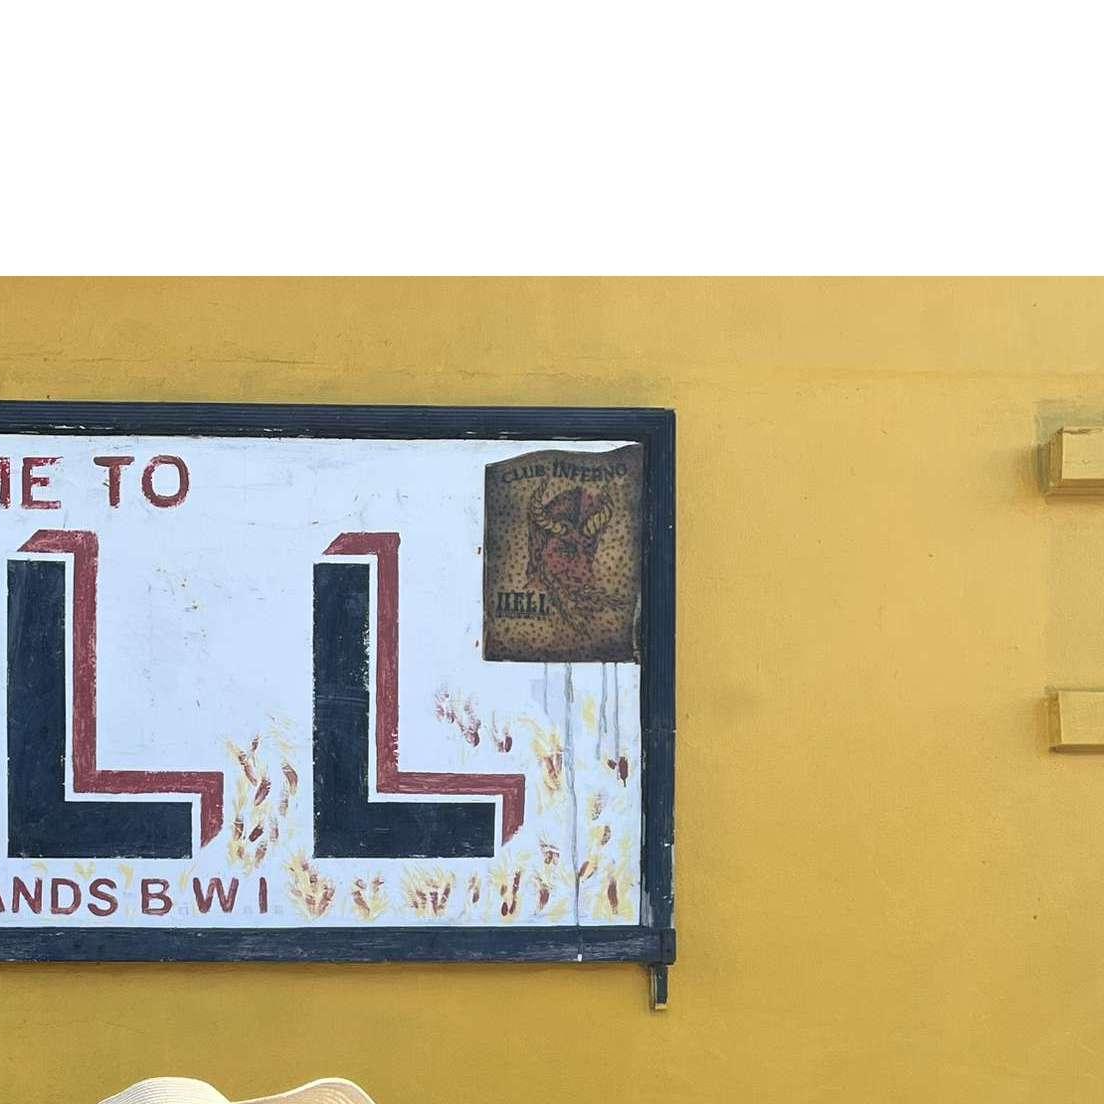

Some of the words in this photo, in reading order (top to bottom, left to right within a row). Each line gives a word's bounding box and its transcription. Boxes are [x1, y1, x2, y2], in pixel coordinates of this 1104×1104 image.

[94, 454, 190, 508] TO
[141, 878, 173, 916] B
[193, 877, 239, 914] W
